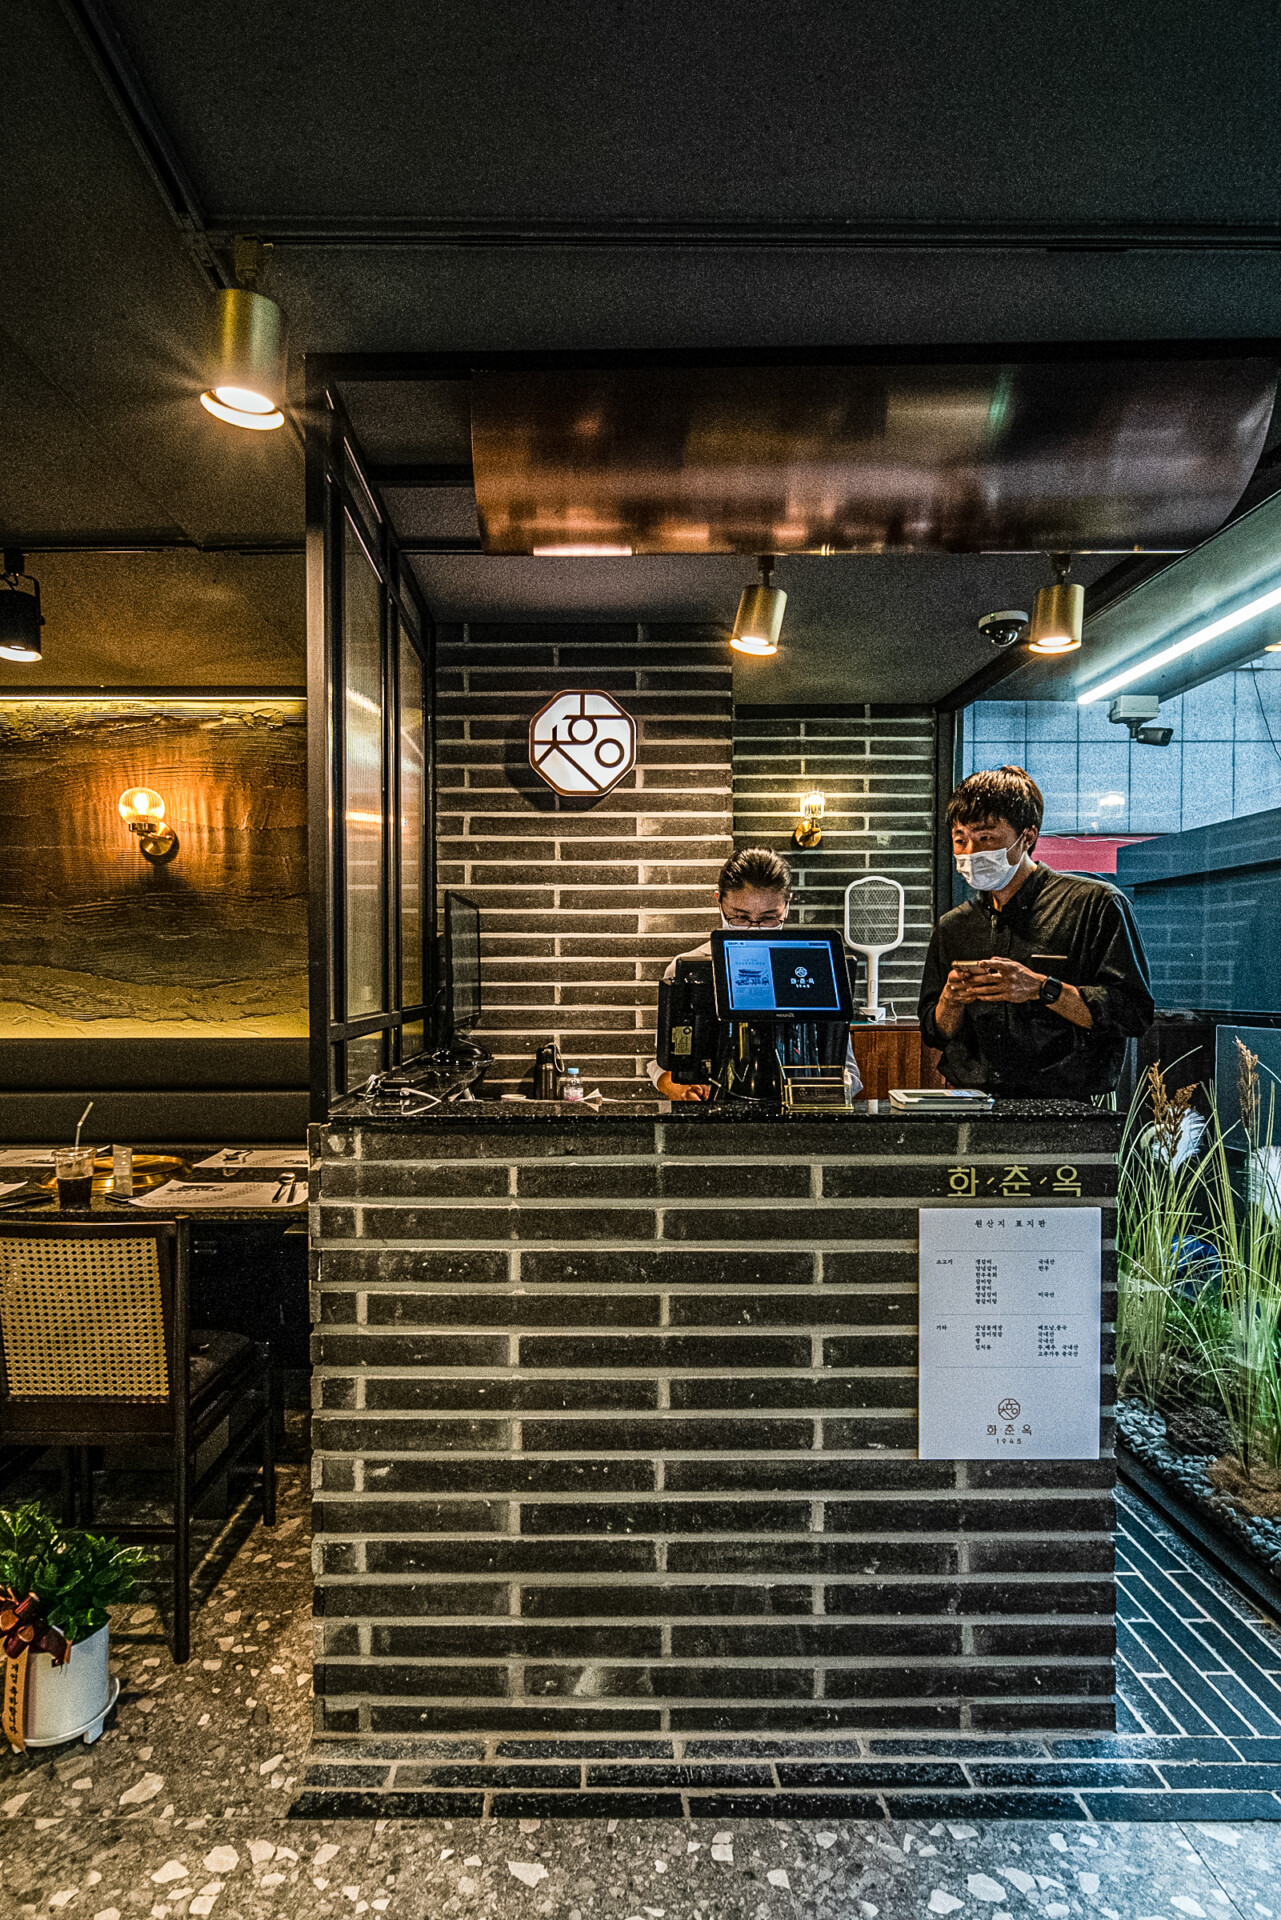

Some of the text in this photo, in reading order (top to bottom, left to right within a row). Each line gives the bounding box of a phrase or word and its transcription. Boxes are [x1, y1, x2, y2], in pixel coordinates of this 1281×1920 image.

[974, 1218, 1046, 1229] 원산지 표지판
[996, 1437, 1022, 1445] 1945
